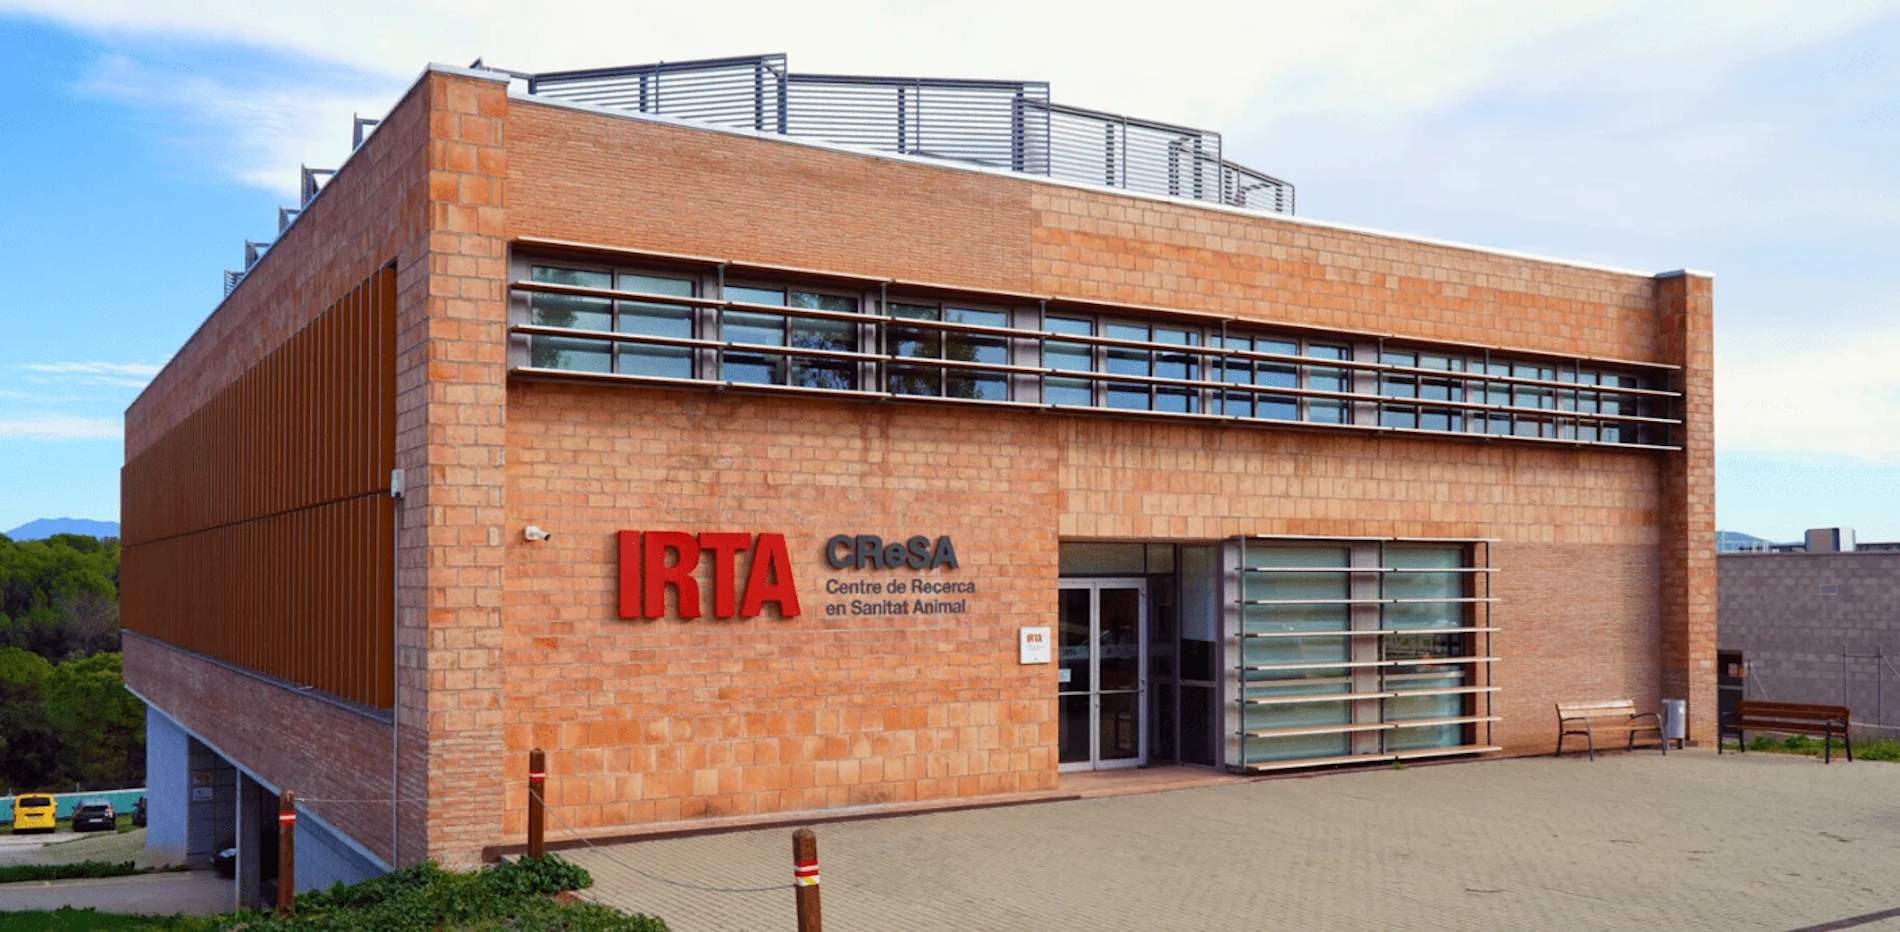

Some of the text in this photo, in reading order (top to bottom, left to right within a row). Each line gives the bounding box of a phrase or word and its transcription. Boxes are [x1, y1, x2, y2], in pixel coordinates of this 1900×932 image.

[825, 534, 958, 570] CReSA
[617, 530, 801, 619] IRTA
[826, 579, 976, 594] Centre de Recerca
[826, 599, 966, 615] en Sanitat Animal
